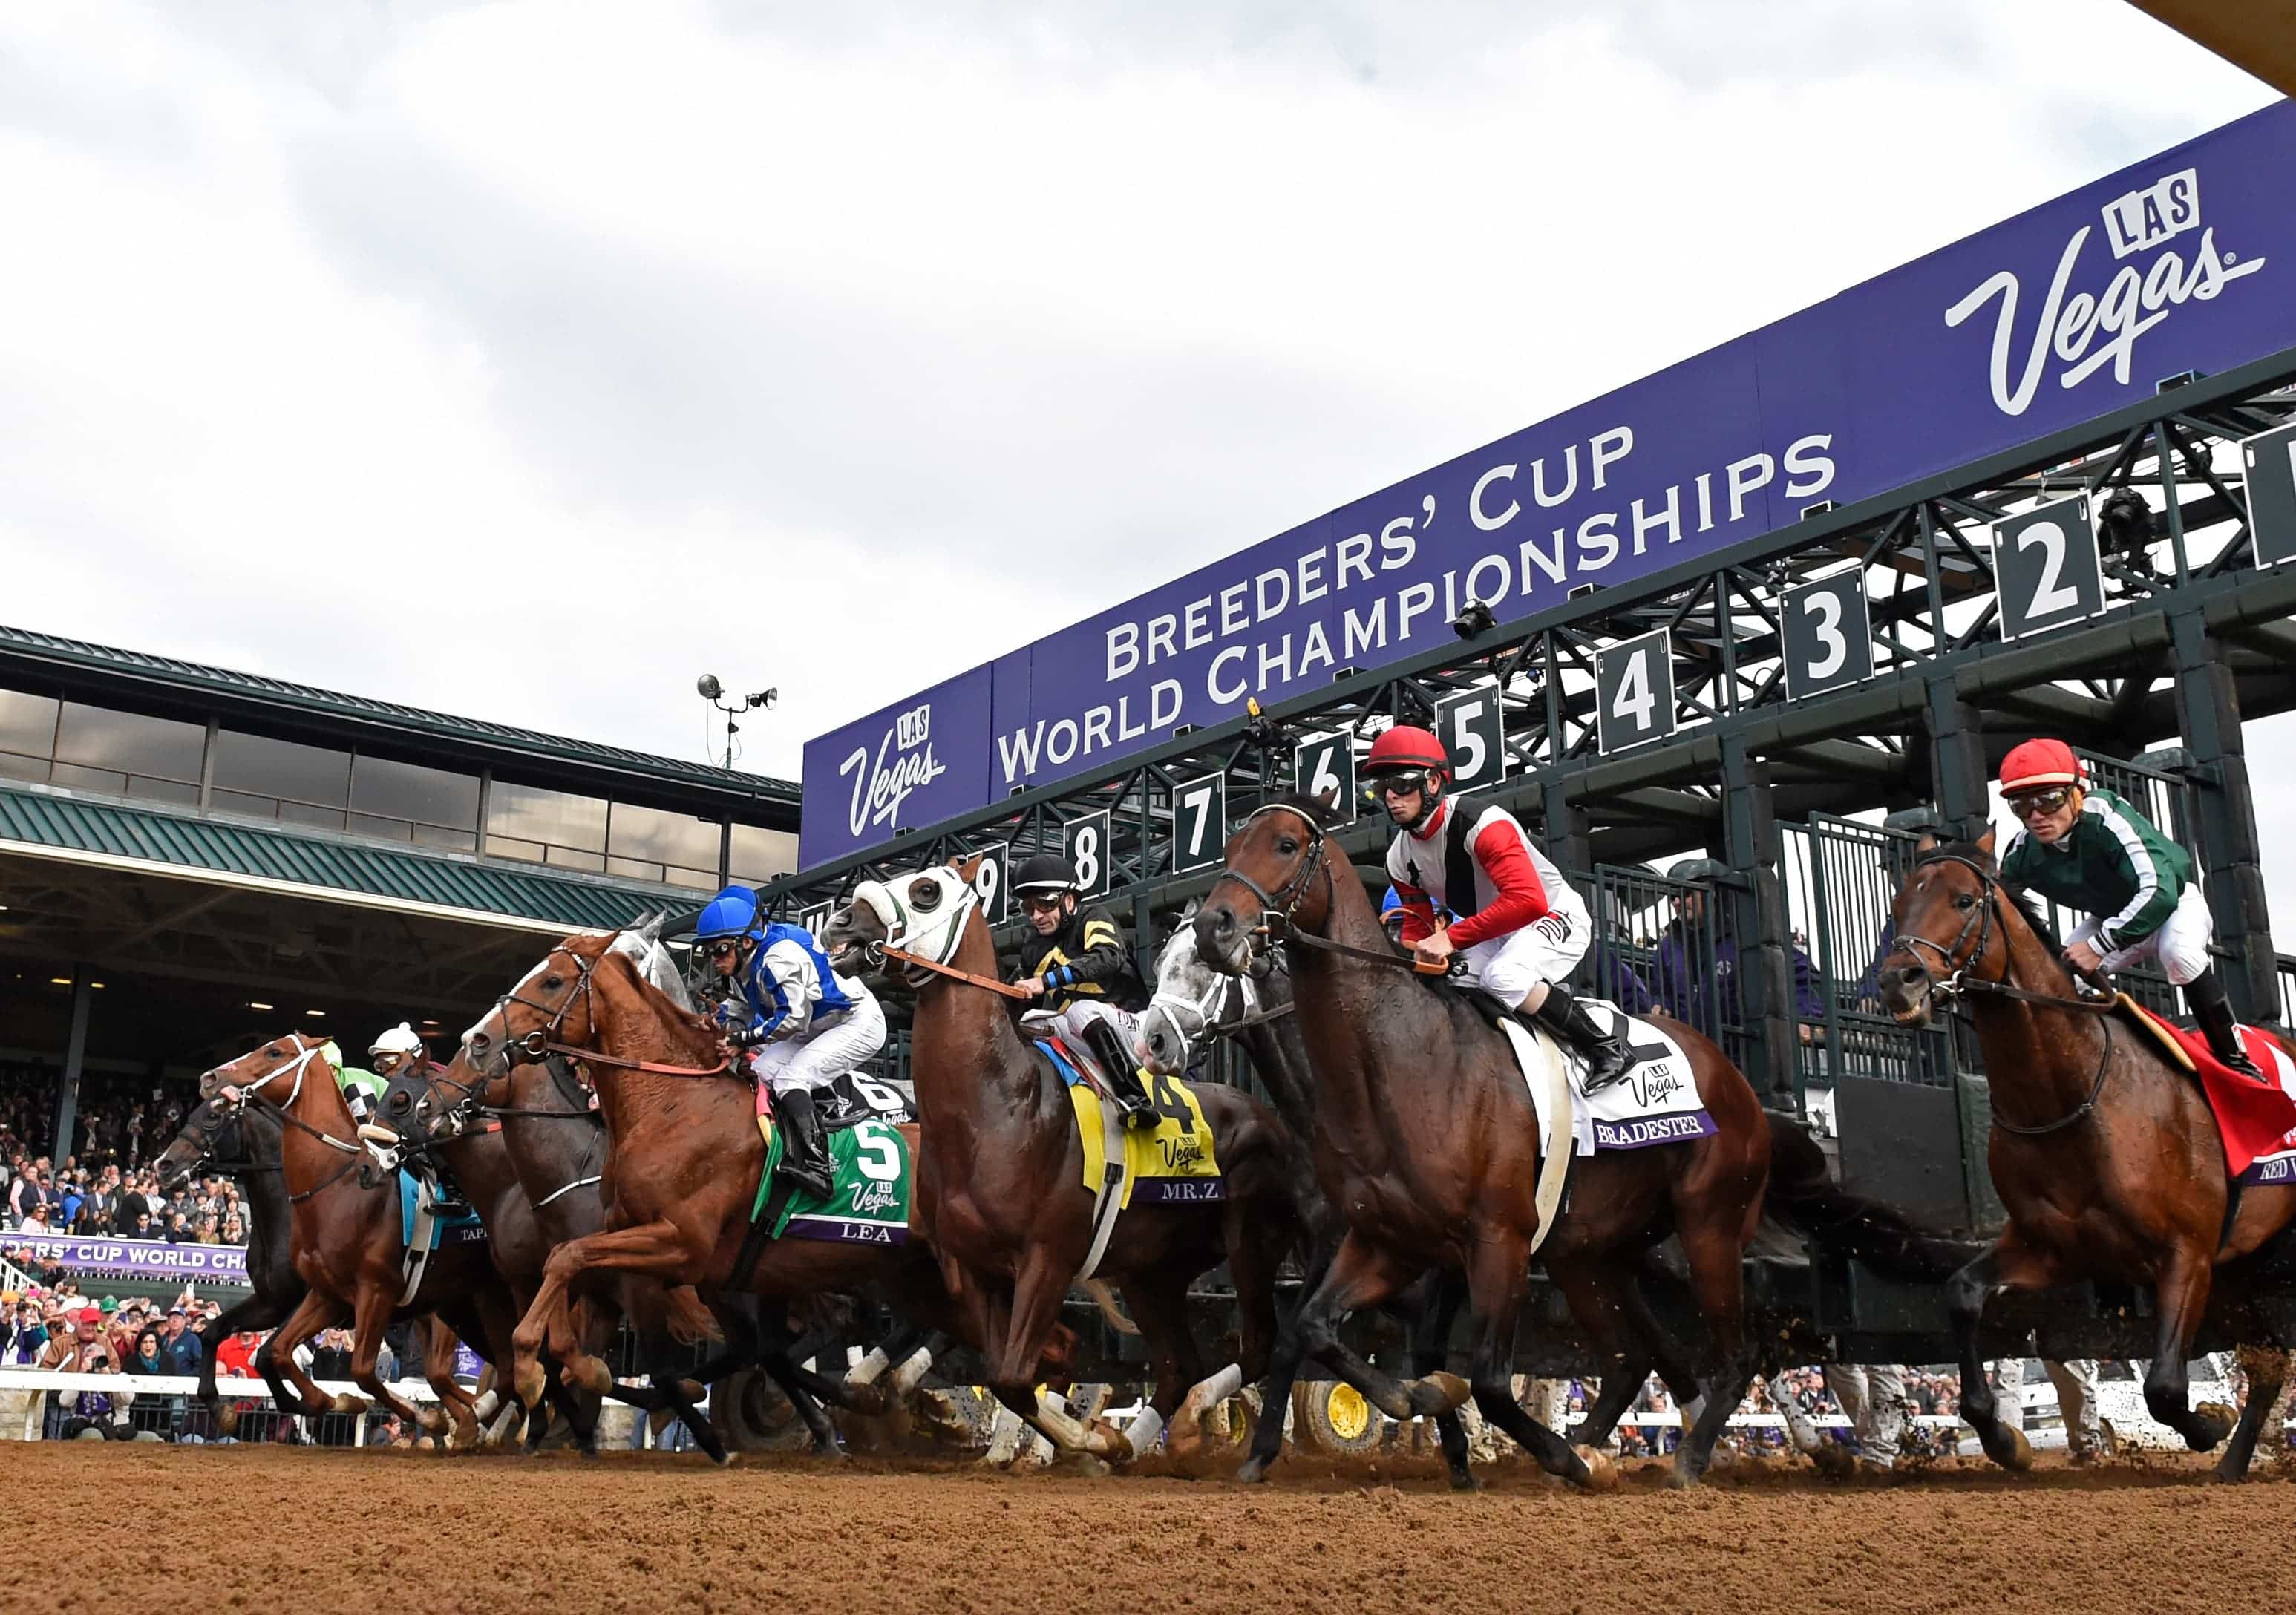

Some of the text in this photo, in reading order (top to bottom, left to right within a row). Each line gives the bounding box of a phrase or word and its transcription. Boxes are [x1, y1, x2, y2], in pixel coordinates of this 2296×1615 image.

[2107, 172, 2196, 253] LAS
[1945, 226, 2265, 415] Vegas
[1105, 426, 1634, 682] BREEDERS’ CUP
[2017, 521, 2078, 620] 2
[997, 434, 1835, 784] WORLD CHAMPIONSHIPS
[1803, 591, 1846, 679] 3
[1612, 649, 1655, 731] 4
[898, 706, 929, 749] LAS
[1454, 700, 1486, 781] 5
[840, 729, 946, 836] Vegas
[1310, 746, 1342, 810] 6
[1185, 787, 1212, 856] 7
[975, 858, 998, 918] 9
[1074, 826, 1099, 891] 8
[846, 1069, 904, 1111] 6
[1152, 1075, 1196, 1135] 4
[1618, 1070, 1684, 1107] Vegas
[853, 1120, 902, 1182] 5
[1155, 1138, 1205, 1171] Vegas
[1596, 1116, 1704, 1145] BRADESTER
[847, 1182, 900, 1216] Vegas
[2259, 1158, 2288, 1180] RED
[77, 1245, 122, 1260] CUP
[128, 1248, 206, 1267] WORLD
[841, 1223, 892, 1242] LEA
